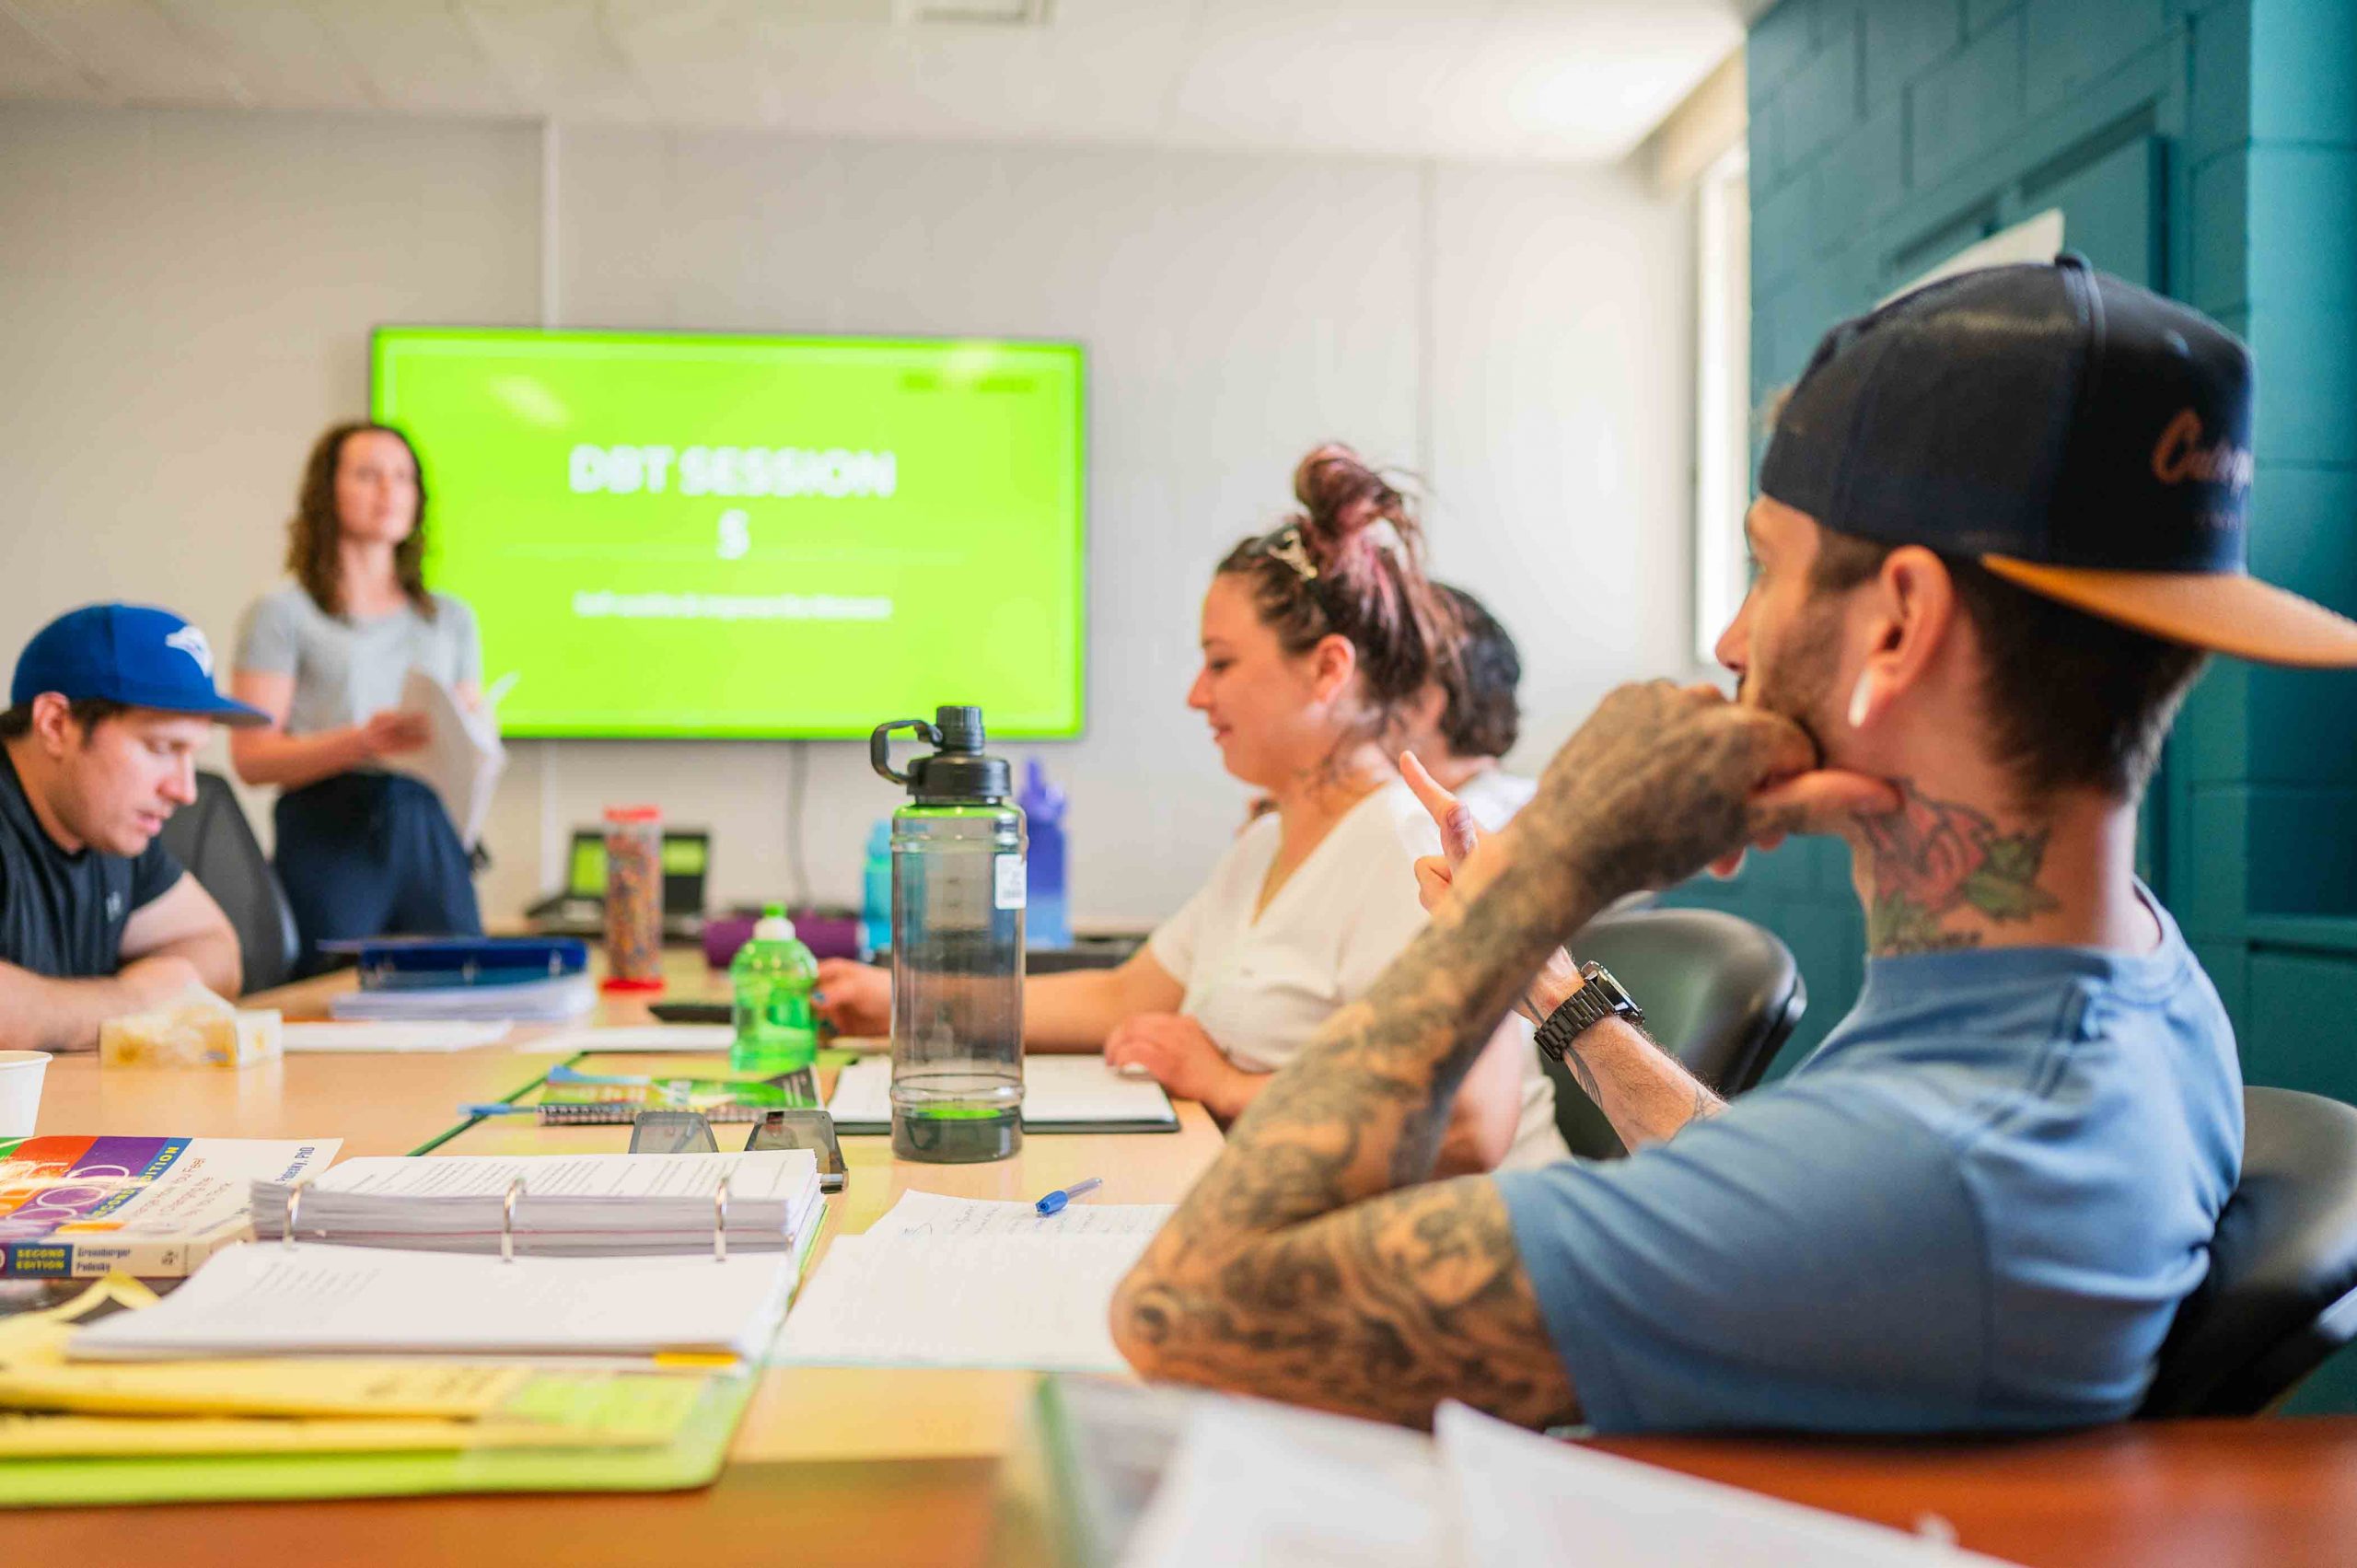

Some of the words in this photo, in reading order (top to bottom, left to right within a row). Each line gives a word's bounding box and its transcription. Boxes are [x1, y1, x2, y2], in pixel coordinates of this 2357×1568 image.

[569, 444, 675, 494] DBT
[678, 446, 897, 498] SESSION
[715, 507, 750, 560] S
[139, 1146, 180, 1185] DITION
[181, 1157, 205, 1173] Feel
[16, 1249, 65, 1259] SECOND
[16, 1260, 65, 1272] EDITION
